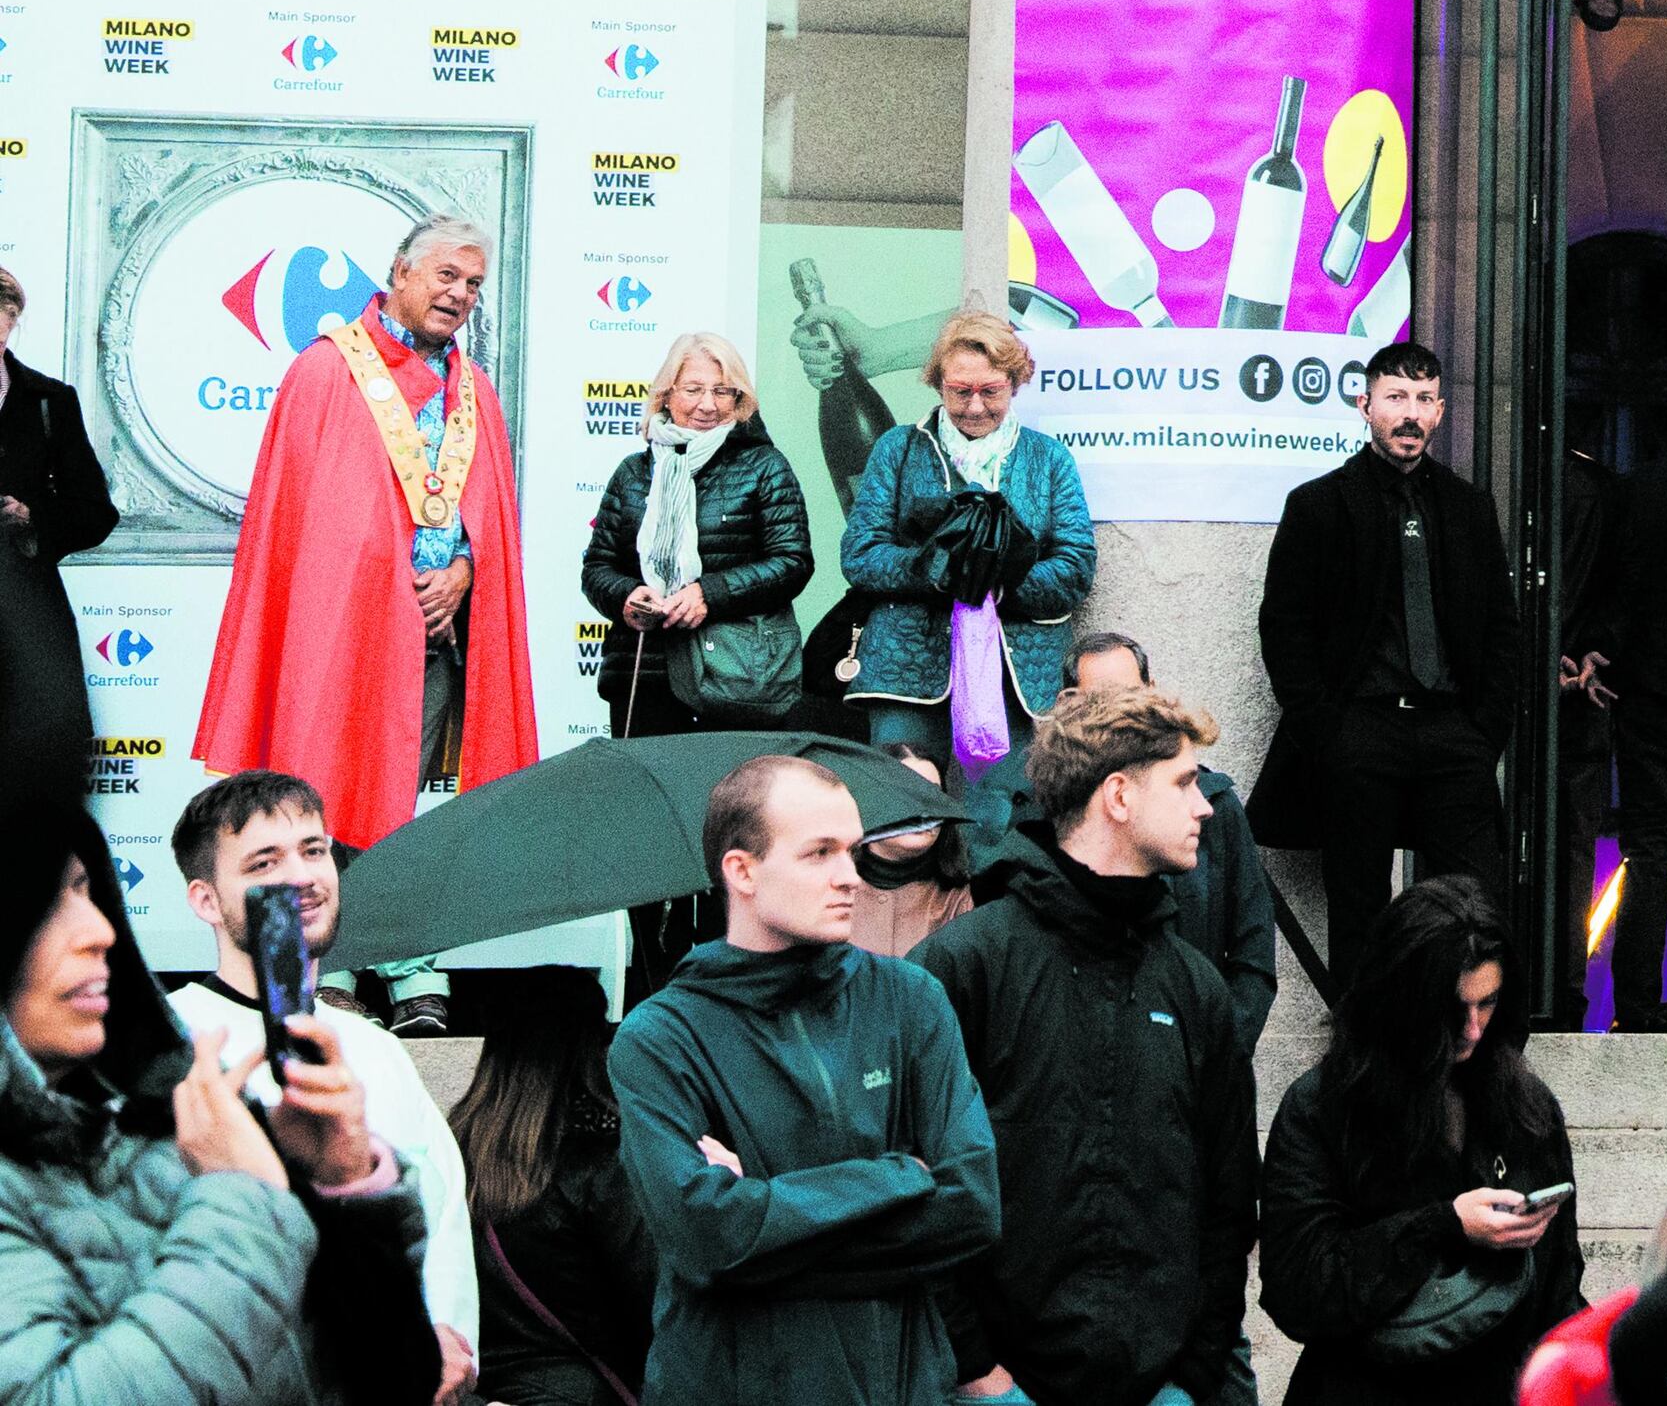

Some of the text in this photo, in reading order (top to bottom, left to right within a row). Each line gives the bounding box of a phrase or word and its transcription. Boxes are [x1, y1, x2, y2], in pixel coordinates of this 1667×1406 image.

[269, 11, 355, 24] Main Sponsor
[106, 21, 190, 36] MILANO
[592, 21, 676, 32] Main Sponsor
[435, 30, 516, 45] MILANO
[105, 40, 163, 55] WINE
[434, 49, 489, 63] WINE
[105, 59, 168, 74] WEEK
[433, 67, 495, 82] WEEK
[274, 79, 343, 90] Carrefour
[597, 87, 664, 99] Carrefour
[596, 155, 675, 169] MILANO
[594, 173, 649, 188] WINE
[594, 192, 655, 206] WEEK
[584, 253, 668, 265] Main Sponsor
[590, 319, 657, 331] Carrefour
[1041, 368, 1166, 392] FOLLOW
[1179, 368, 1219, 390] US
[588, 383, 650, 397] MILAN
[586, 402, 642, 416] WINE
[1057, 426, 1362, 454] www.milanowineweek.c
[576, 482, 605, 492] Main
[83, 606, 172, 618] Main Sponsor
[88, 674, 159, 687] Carrefour
[568, 725, 597, 735] Main
[94, 740, 161, 754] ILANO
[108, 834, 162, 845] Sponsor
